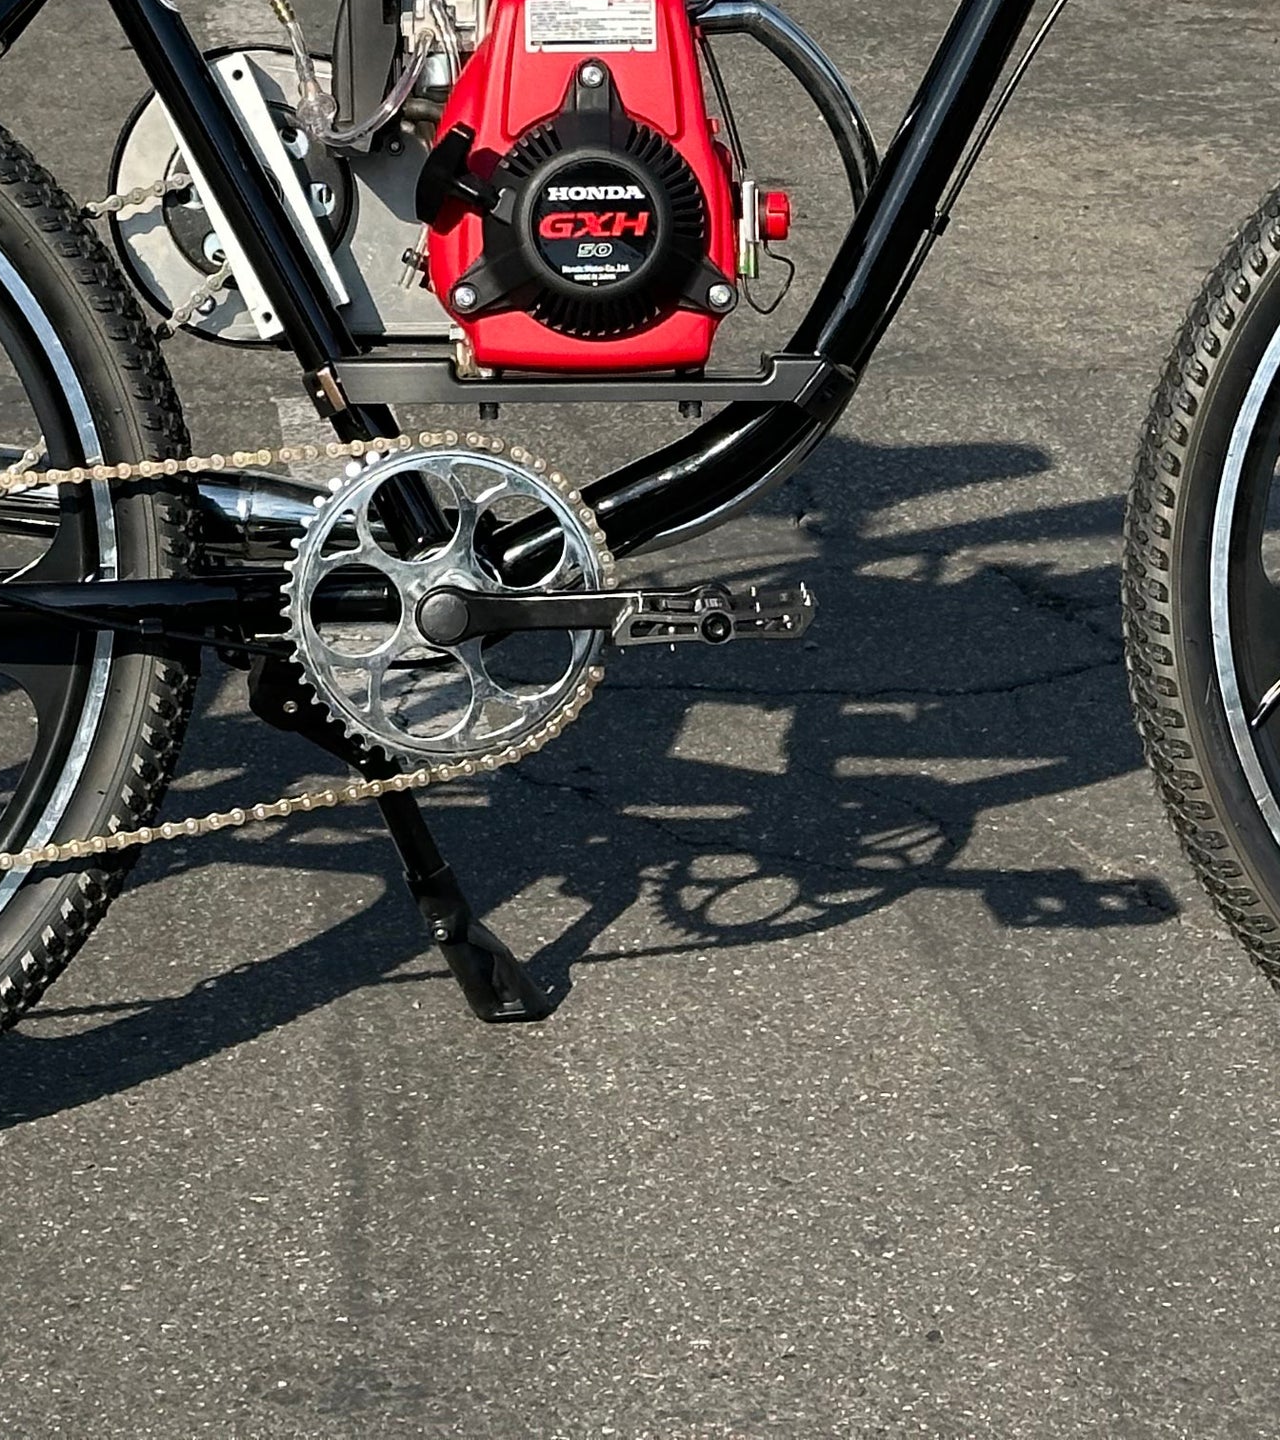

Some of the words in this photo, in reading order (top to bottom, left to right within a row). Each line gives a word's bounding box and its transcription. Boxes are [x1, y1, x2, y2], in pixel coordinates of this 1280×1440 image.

[547, 185, 645, 201] HONDA
[539, 211, 650, 239] GXH
[577, 242, 613, 258] 50
